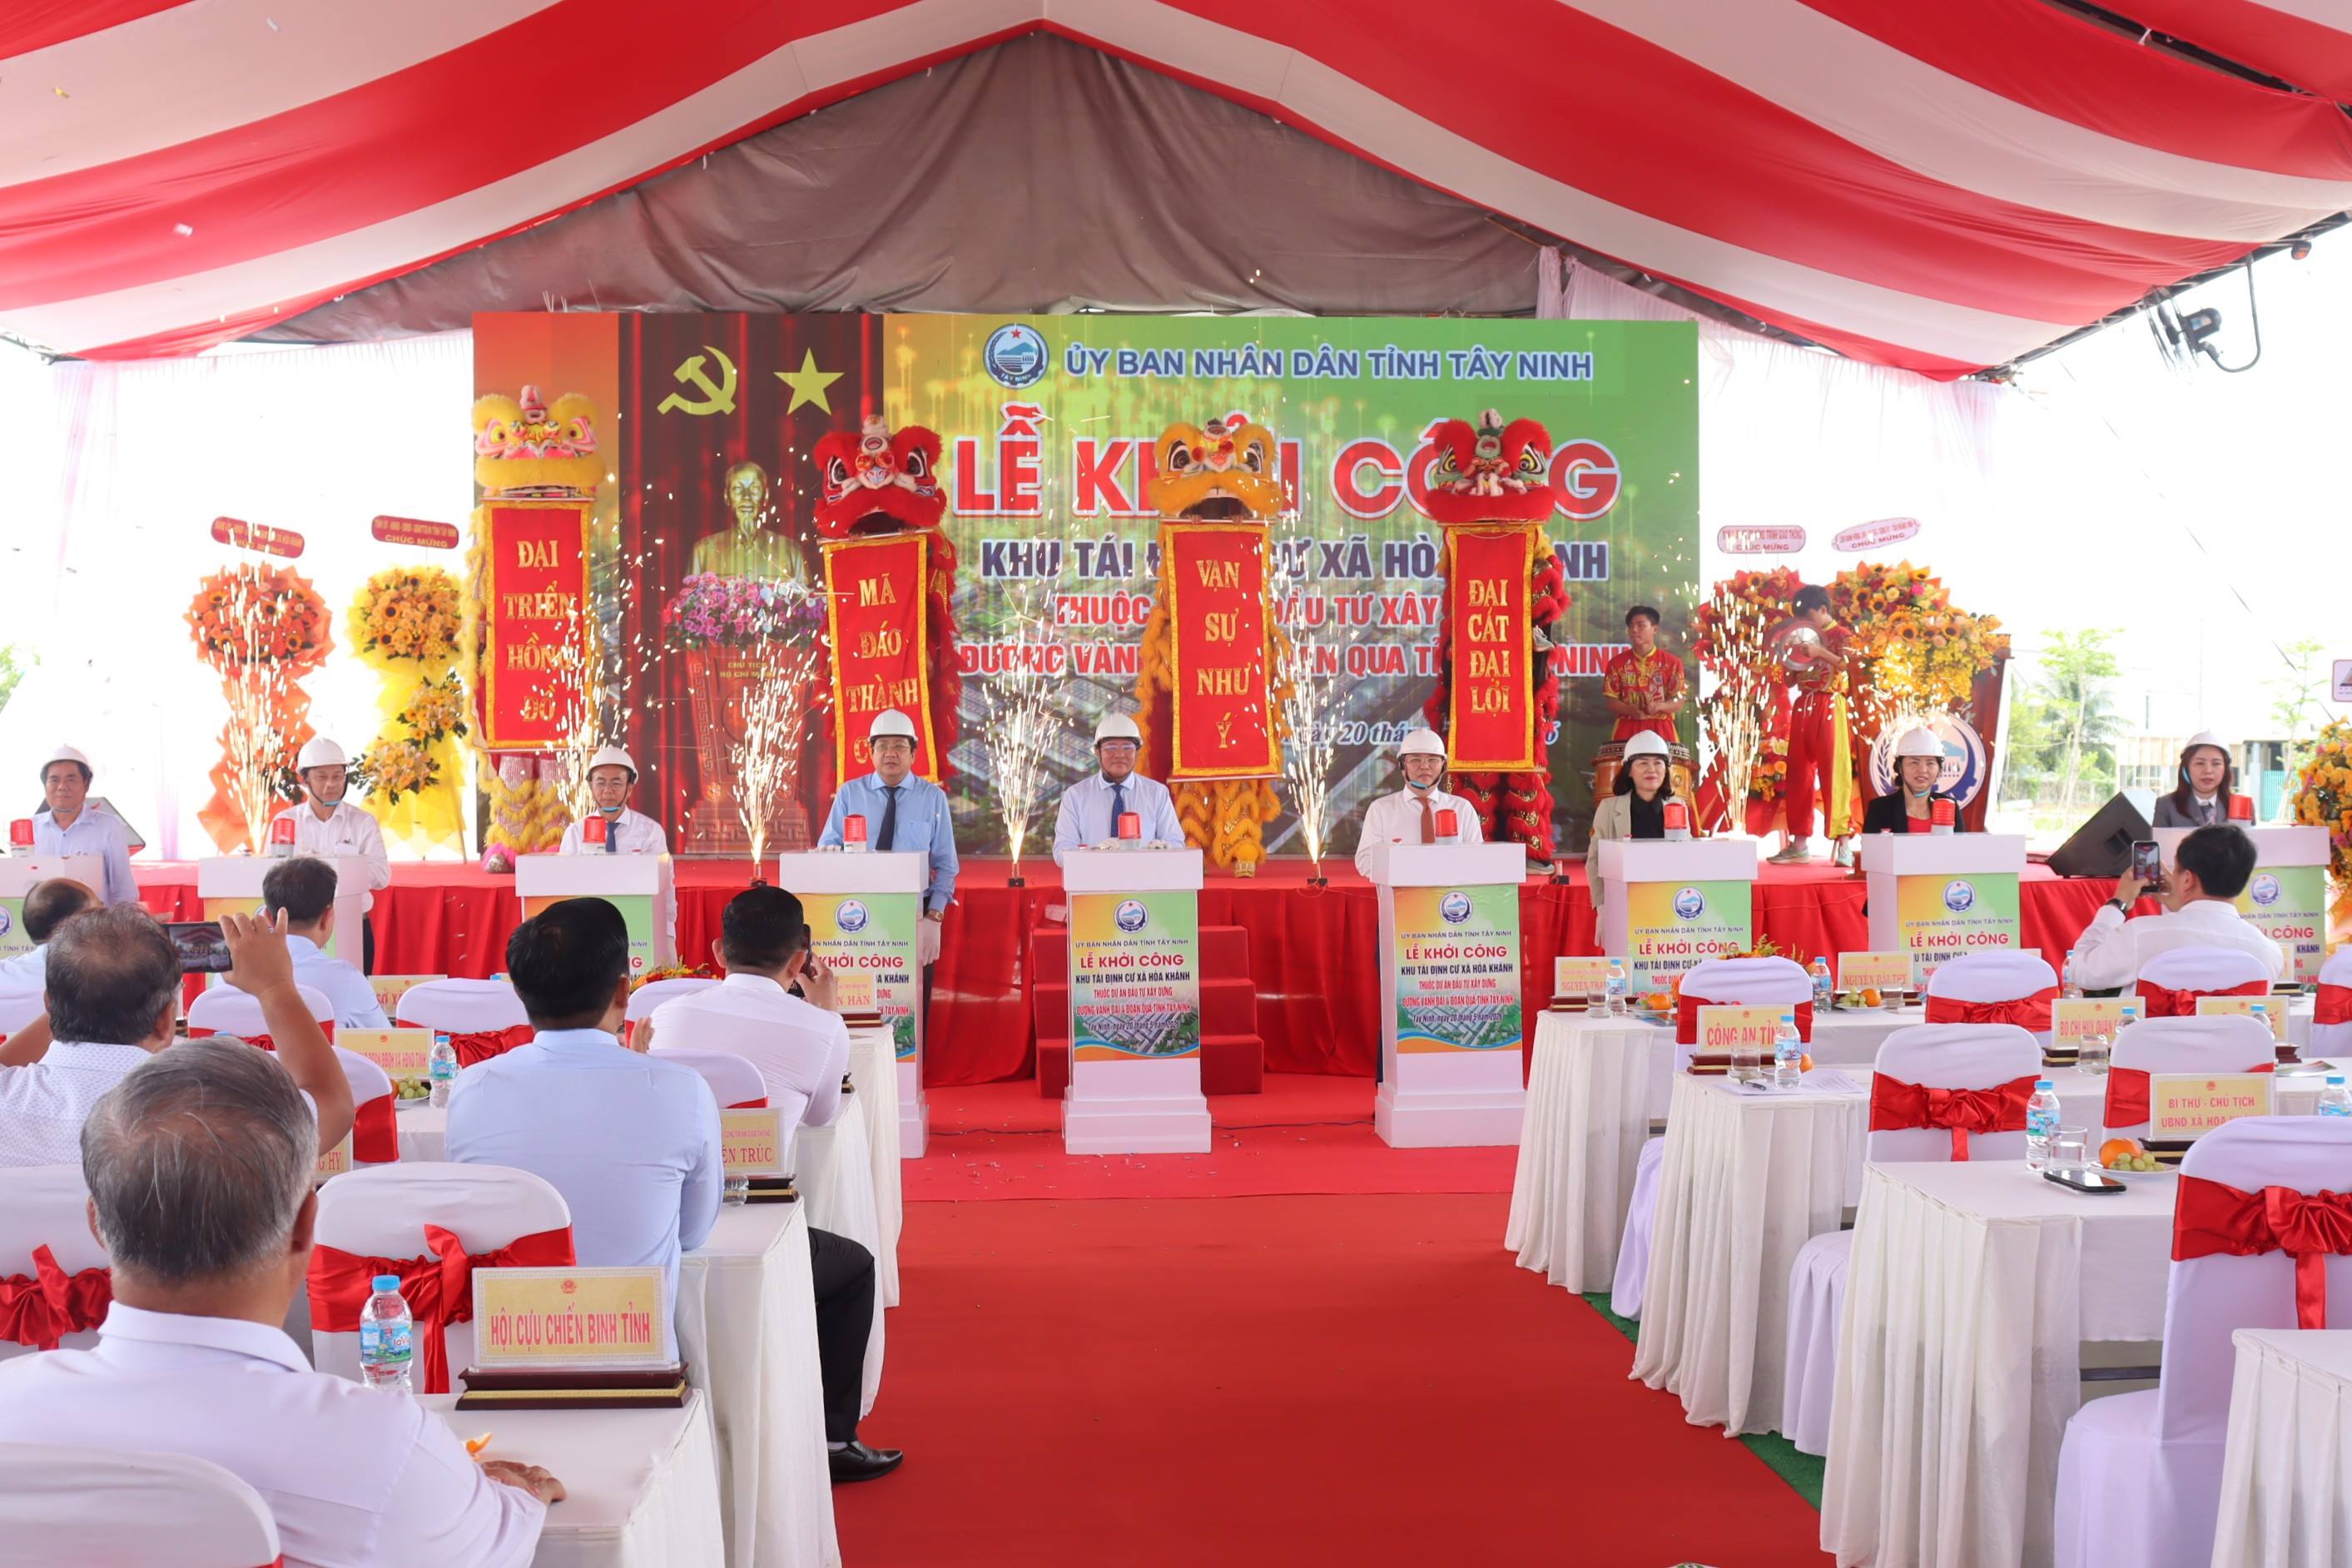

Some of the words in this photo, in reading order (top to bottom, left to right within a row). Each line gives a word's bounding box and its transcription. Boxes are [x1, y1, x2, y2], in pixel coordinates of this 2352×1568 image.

[1067, 343, 1109, 375] ỦY
[1118, 350, 1183, 376] BAN
[1194, 345, 1283, 376] NHÂN
[1293, 345, 1358, 376] DÂN
[1367, 346, 1439, 377] TỈNH
[1448, 346, 1511, 378] TÂY
[1518, 353, 1591, 378] NINH
[954, 402, 1044, 516] LỄ
[517, 539, 559, 573] ĐẠI
[982, 540, 1061, 578] KHU
[1074, 533, 1133, 578] TÁI
[1319, 535, 1372, 578] XÃ
[858, 573, 897, 607] MÃ
[1195, 559, 1241, 592] VẠN
[1468, 578, 1509, 608] ĐẠI
[1054, 592, 1151, 631] THUỘC
[1333, 594, 1374, 625] TƯ
[1379, 591, 1438, 625] XÂY
[1204, 606, 1238, 647] SỰ
[1467, 606, 1510, 643] CÁT
[858, 621, 903, 659] ĐÁO
[1347, 646, 1407, 677] QUA
[1469, 649, 1511, 682] ĐẠI
[846, 675, 919, 713] THÀNH
[1196, 662, 1252, 696] NHƯ
[1639, 938, 1652, 955] LỄ
[1657, 939, 1691, 955] KHỞI
[1910, 930, 1923, 947] LỄ
[1928, 930, 1961, 946] KHỞI
[1966, 930, 2009, 945] CÔNG
[2272, 925, 2314, 939] CÔNG
[858, 954, 904, 968] CÔNG
[1080, 951, 1094, 969] LỄ
[1099, 952, 1134, 968] KHỞI
[1139, 951, 1184, 967] CÔNG
[1406, 943, 1419, 960] LỄ
[1424, 944, 1459, 960] KHỞI
[1463, 943, 1507, 959] CÔNG
[1707, 1022, 1738, 1046] CÔNG
[1741, 1027, 1756, 1045] AN
[2181, 1097, 2201, 1109] THƯ
[2210, 1093, 2230, 1108] CHỦ
[2233, 1096, 2255, 1110] TỊCH
[2161, 1117, 2187, 1128] UBND
[490, 1306, 513, 1352] HỘI
[516, 1309, 542, 1352] CỰU
[545, 1301, 583, 1345] CHIẾN
[587, 1312, 618, 1345] BINH
[620, 1300, 651, 1344] TỈNH
